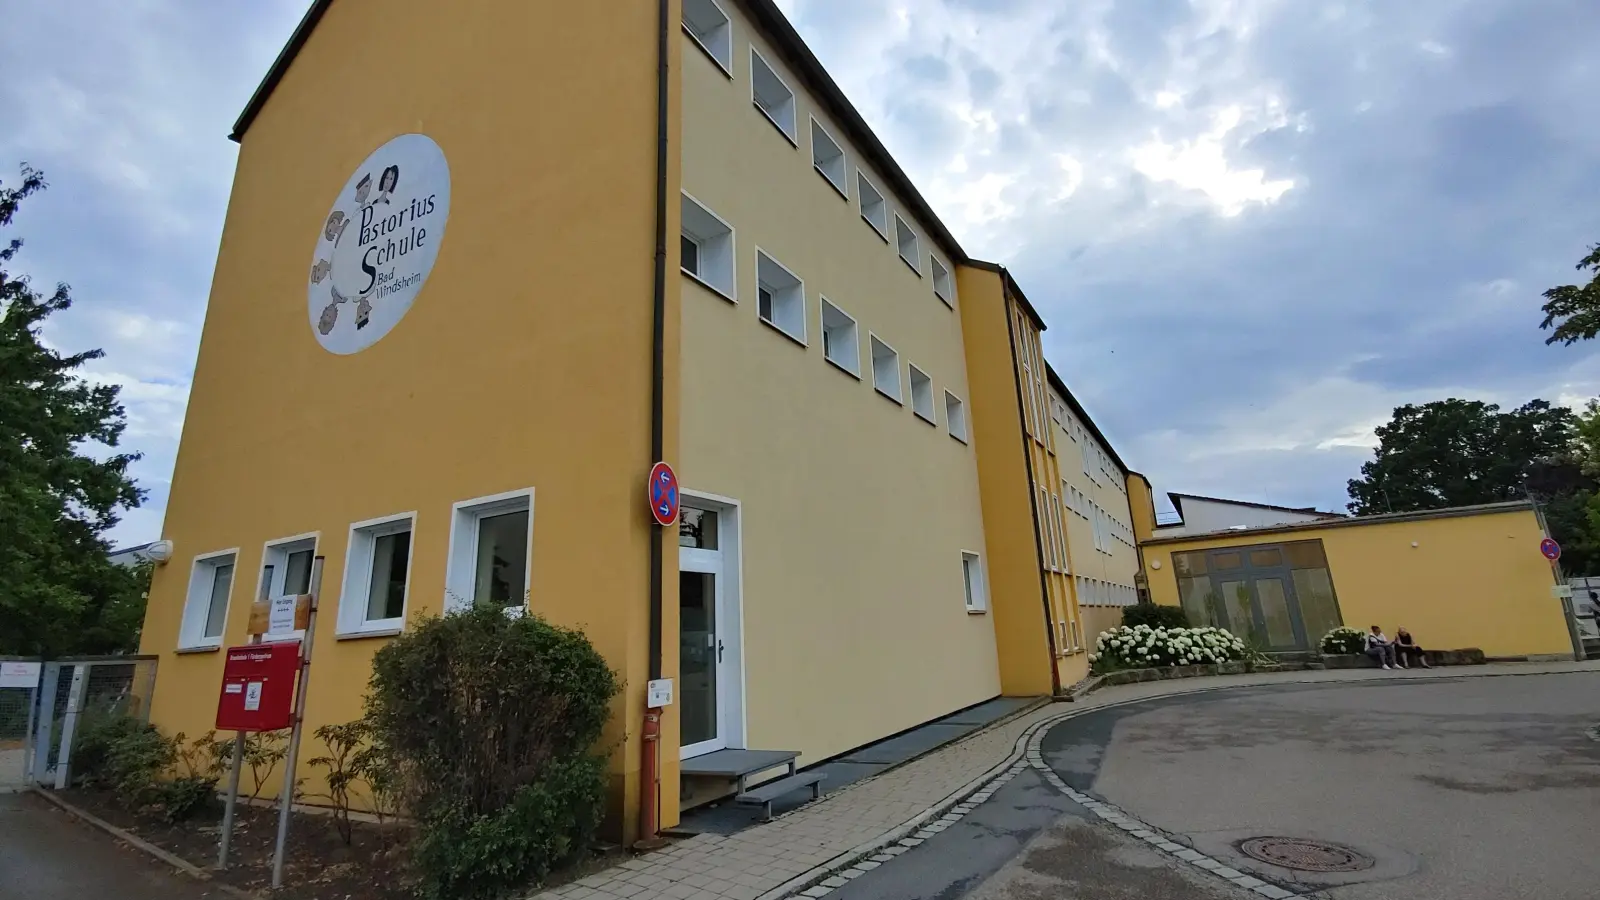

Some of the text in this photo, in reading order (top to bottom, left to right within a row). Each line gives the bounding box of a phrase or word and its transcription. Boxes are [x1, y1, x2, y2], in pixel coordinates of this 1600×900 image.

[358, 194, 436, 247] Pastorius
[359, 226, 427, 295] Schule
[377, 266, 396, 286] Bad
[376, 272, 421, 299] Windsheim
